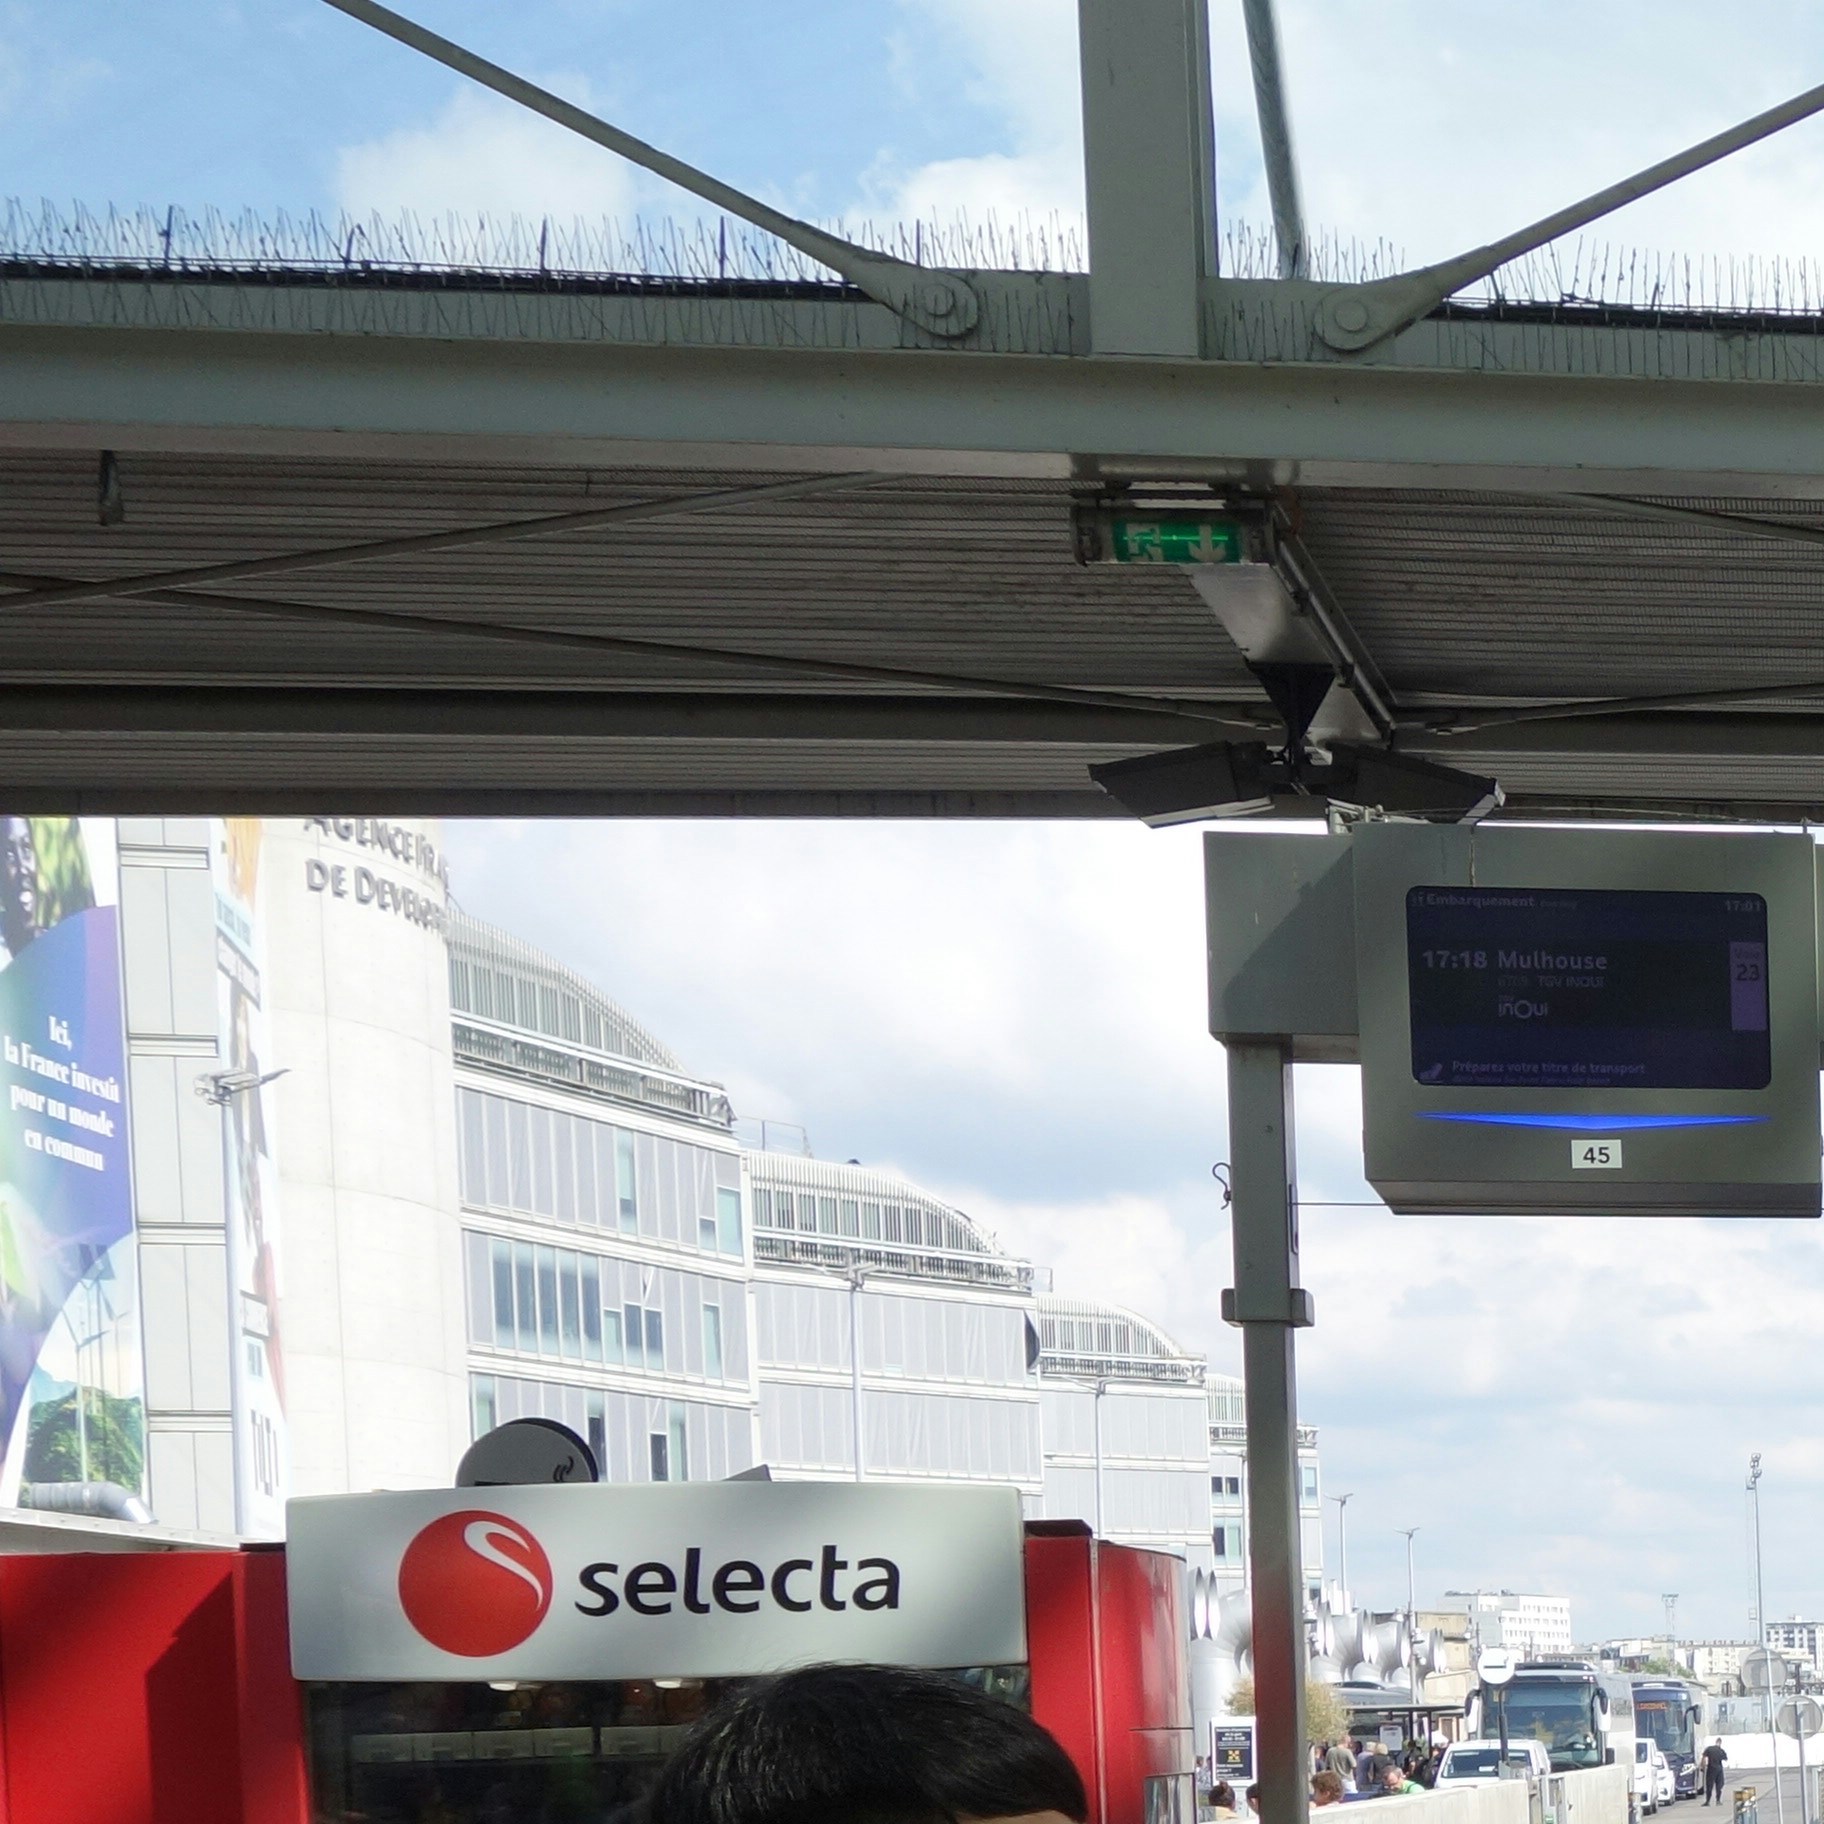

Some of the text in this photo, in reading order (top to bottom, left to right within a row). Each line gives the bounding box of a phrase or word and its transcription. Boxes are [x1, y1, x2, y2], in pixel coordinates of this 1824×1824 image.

[306, 858, 348, 898] DE
[1427, 894, 1534, 910] Embarquement
[1422, 949, 1607, 970] 17:18 Mulhouse
[1736, 965, 1760, 981] 23
[49, 1016, 72, 1051] Ici,
[4, 1036, 19, 1065] la
[21, 1042, 69, 1084] France
[10, 1085, 114, 1137] pour un monde
[24, 1129, 42, 1150] en
[1581, 1147, 1611, 1165] 45
[574, 1543, 901, 1618] selecta
